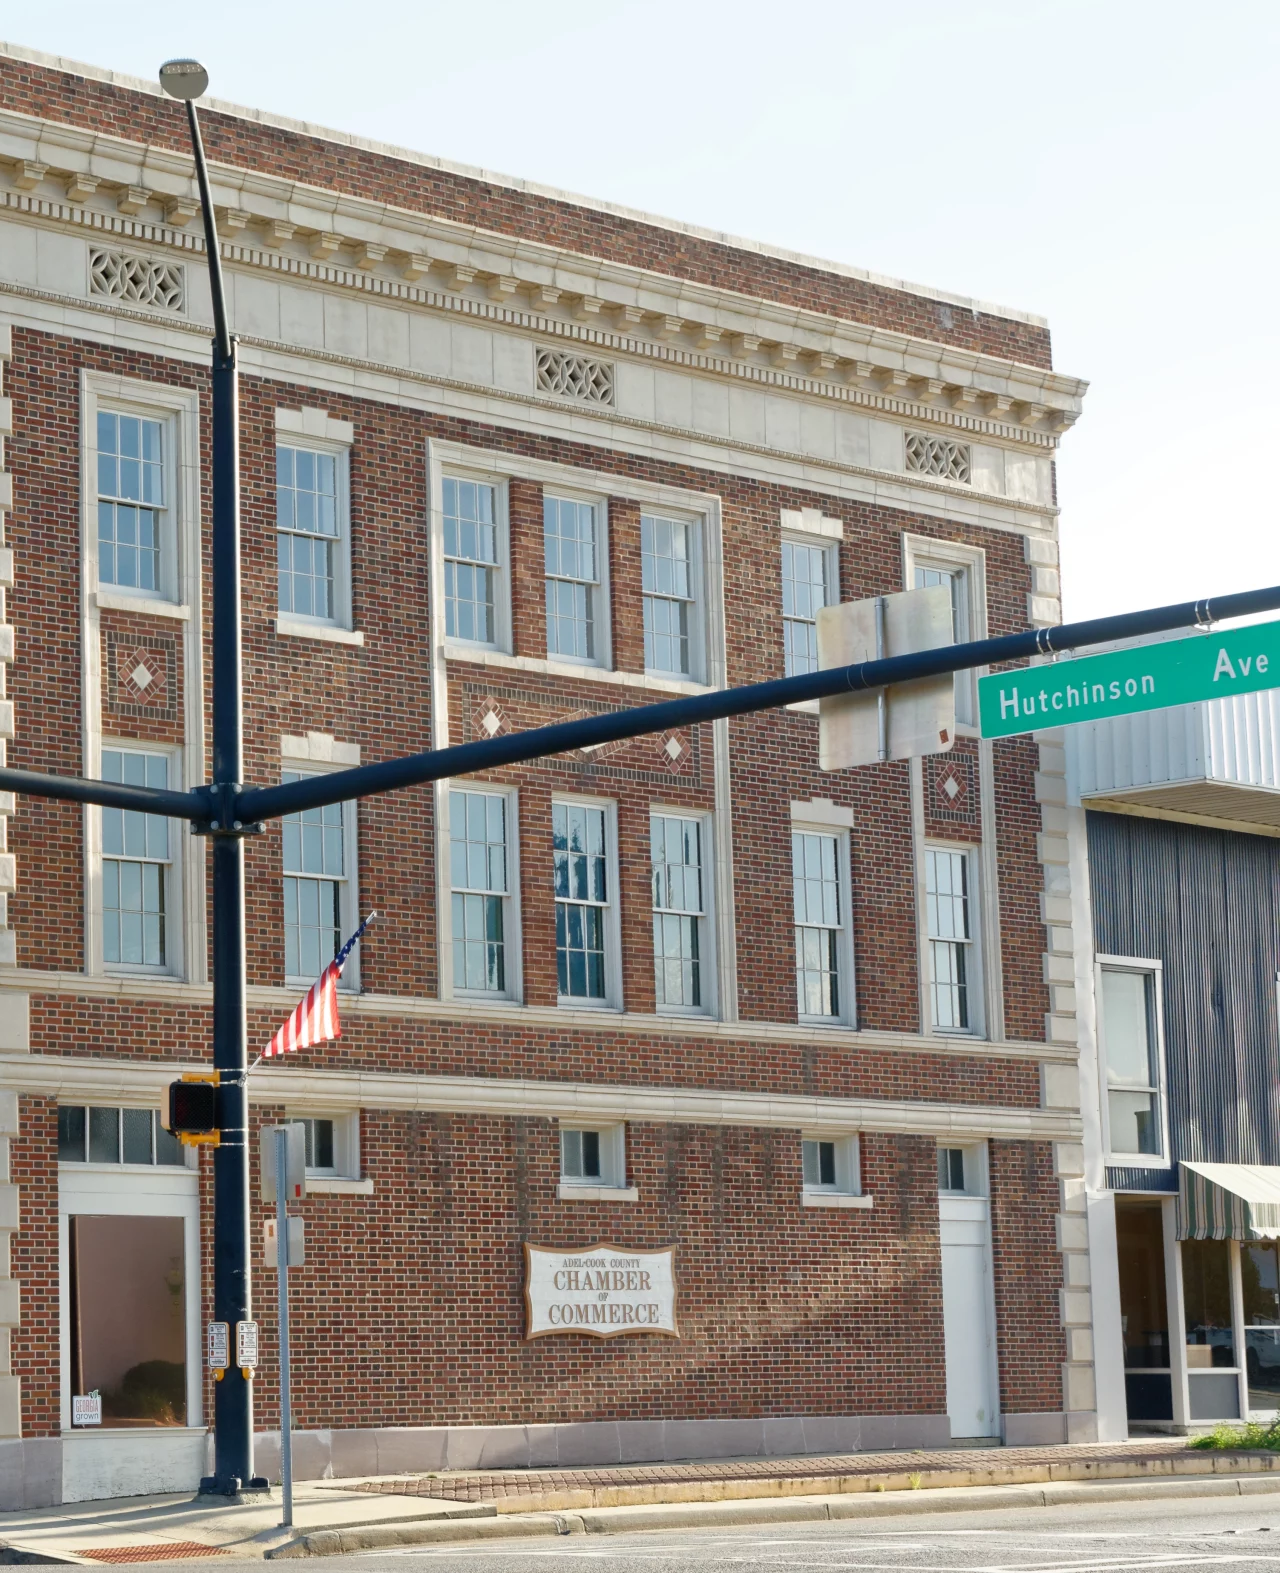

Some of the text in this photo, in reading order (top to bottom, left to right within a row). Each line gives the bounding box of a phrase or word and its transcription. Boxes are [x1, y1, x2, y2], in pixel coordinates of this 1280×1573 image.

[999, 647, 1269, 720] Hutchinson Ave
[562, 1258, 641, 1268] ADEL-COOK COUNTY
[553, 1270, 652, 1291] CHAMBER
[598, 1292, 609, 1302] OF
[548, 1303, 660, 1325] COMMERCE
[76, 1400, 99, 1412] GEORGIA
[76, 1413, 98, 1421] grown
